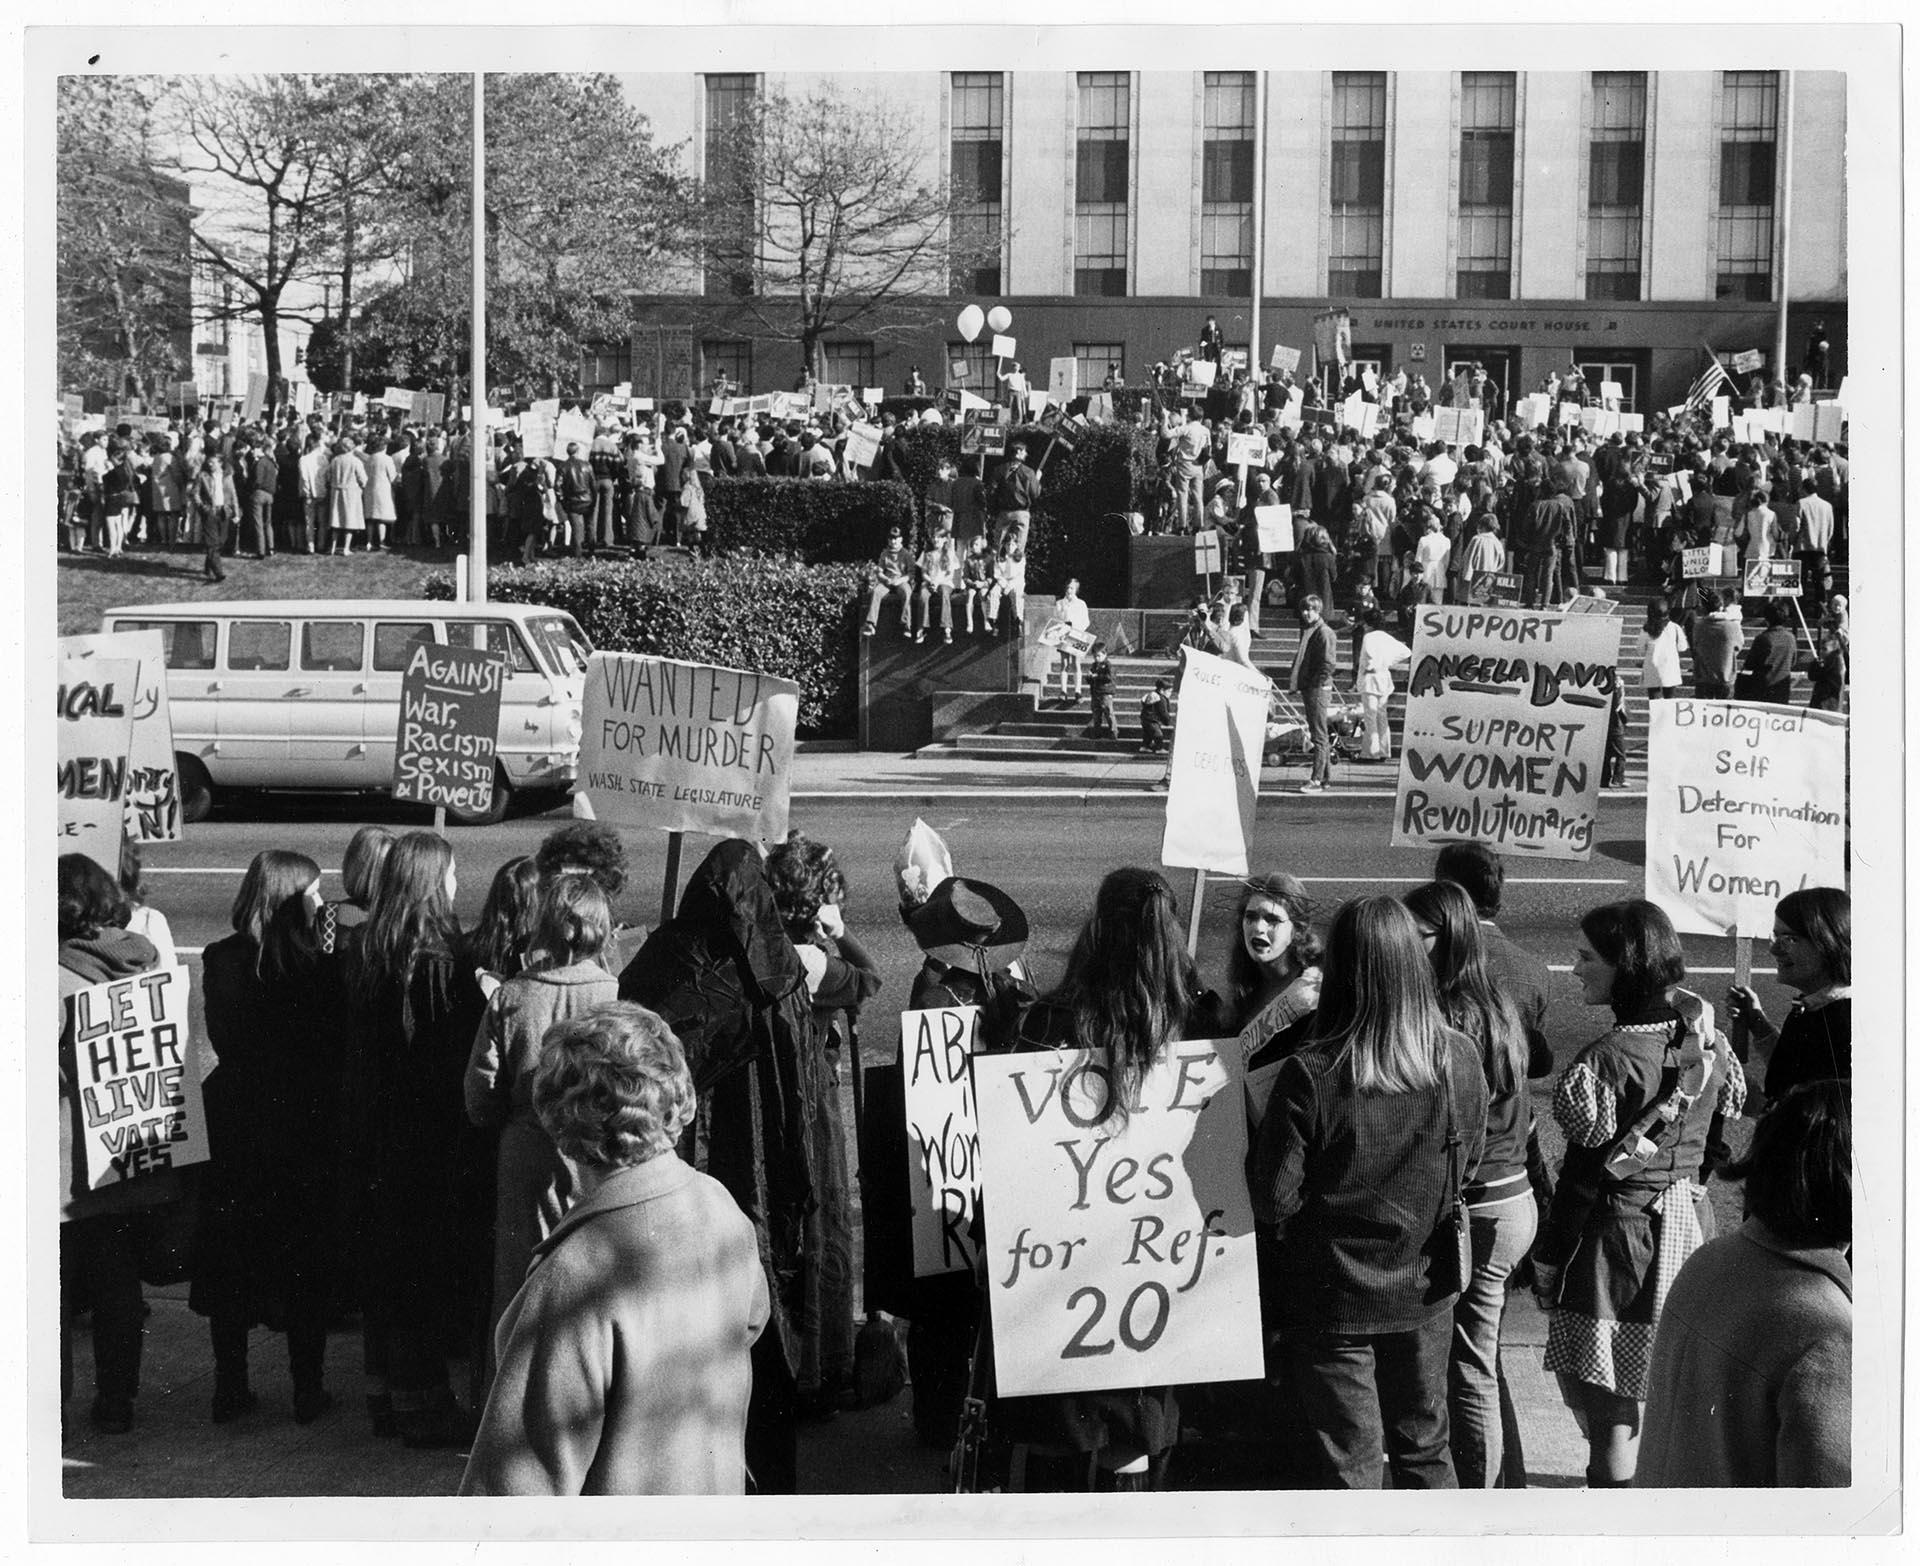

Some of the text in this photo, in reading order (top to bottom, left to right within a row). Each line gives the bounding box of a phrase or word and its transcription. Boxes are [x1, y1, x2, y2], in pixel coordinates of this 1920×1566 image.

[1374, 320, 1590, 331] UNITED STATES COURT HOUSE
[1496, 577, 1516, 589] KILL
[1423, 611, 1562, 643] SUPPORT
[408, 645, 504, 693] AGAINST
[603, 656, 760, 726] WANTED
[1410, 653, 1617, 707] ANGELA DAVIS
[405, 690, 460, 729] War,
[1675, 701, 1804, 748] Biological
[404, 723, 494, 758] Racism
[602, 719, 775, 775] FOR MURDER
[399, 752, 492, 781] Sexism
[1407, 748, 1587, 798] WOMEN
[1715, 750, 1770, 778] Self
[396, 773, 492, 812] & Poverty
[630, 778, 666, 798] STATE
[674, 785, 763, 810] LEGISLATURE
[1678, 785, 1840, 826] Determination
[1402, 789, 1595, 852] Revolutionaries
[1717, 824, 1760, 850] For
[1673, 854, 1781, 898] Women
[78, 972, 172, 1042] LET
[88, 1023, 183, 1083] HER
[83, 1065, 185, 1128] LIVE
[110, 1143, 173, 1180] YES
[1055, 1137, 1174, 1211] Yes
[1001, 1210, 1225, 1293] for Ref.
[1061, 1281, 1171, 1359] 20
